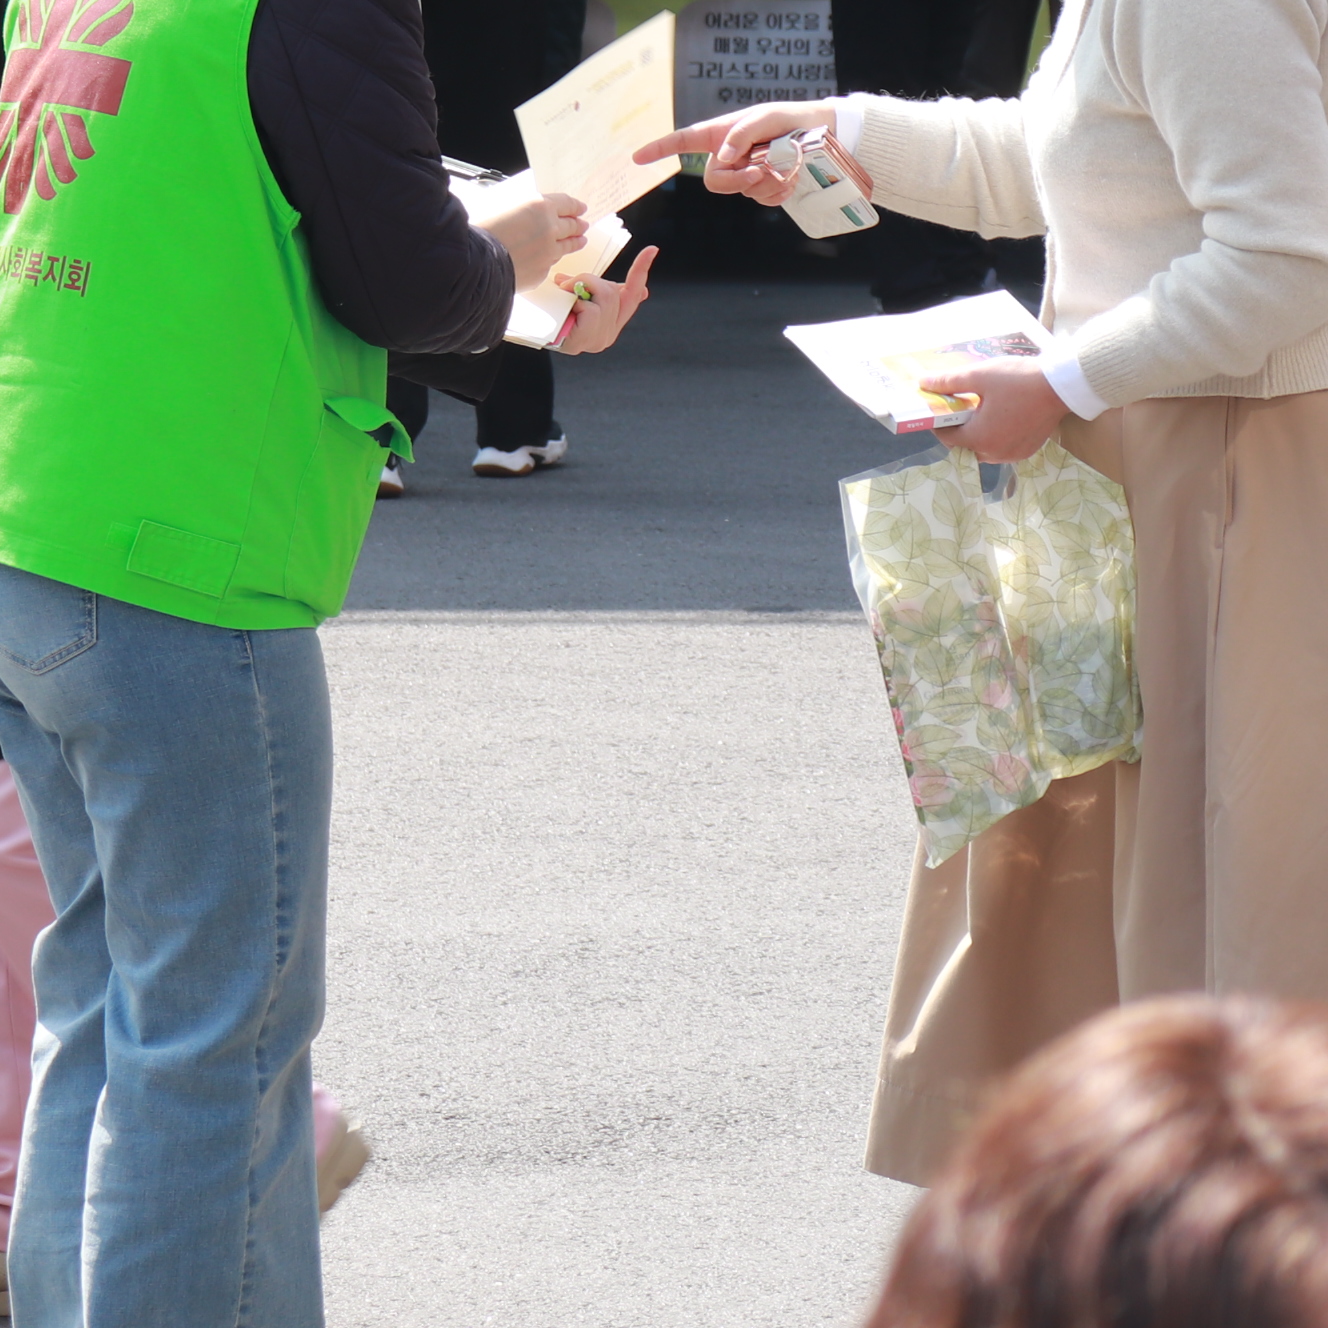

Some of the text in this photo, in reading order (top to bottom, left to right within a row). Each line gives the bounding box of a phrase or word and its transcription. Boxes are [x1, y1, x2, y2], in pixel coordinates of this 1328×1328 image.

[705, 12, 759, 30] 어려운
[767, 13, 820, 31] 이웃을
[714, 37, 750, 54] 매월
[756, 37, 810, 56] 우리의
[688, 62, 779, 80] 그리스도의
